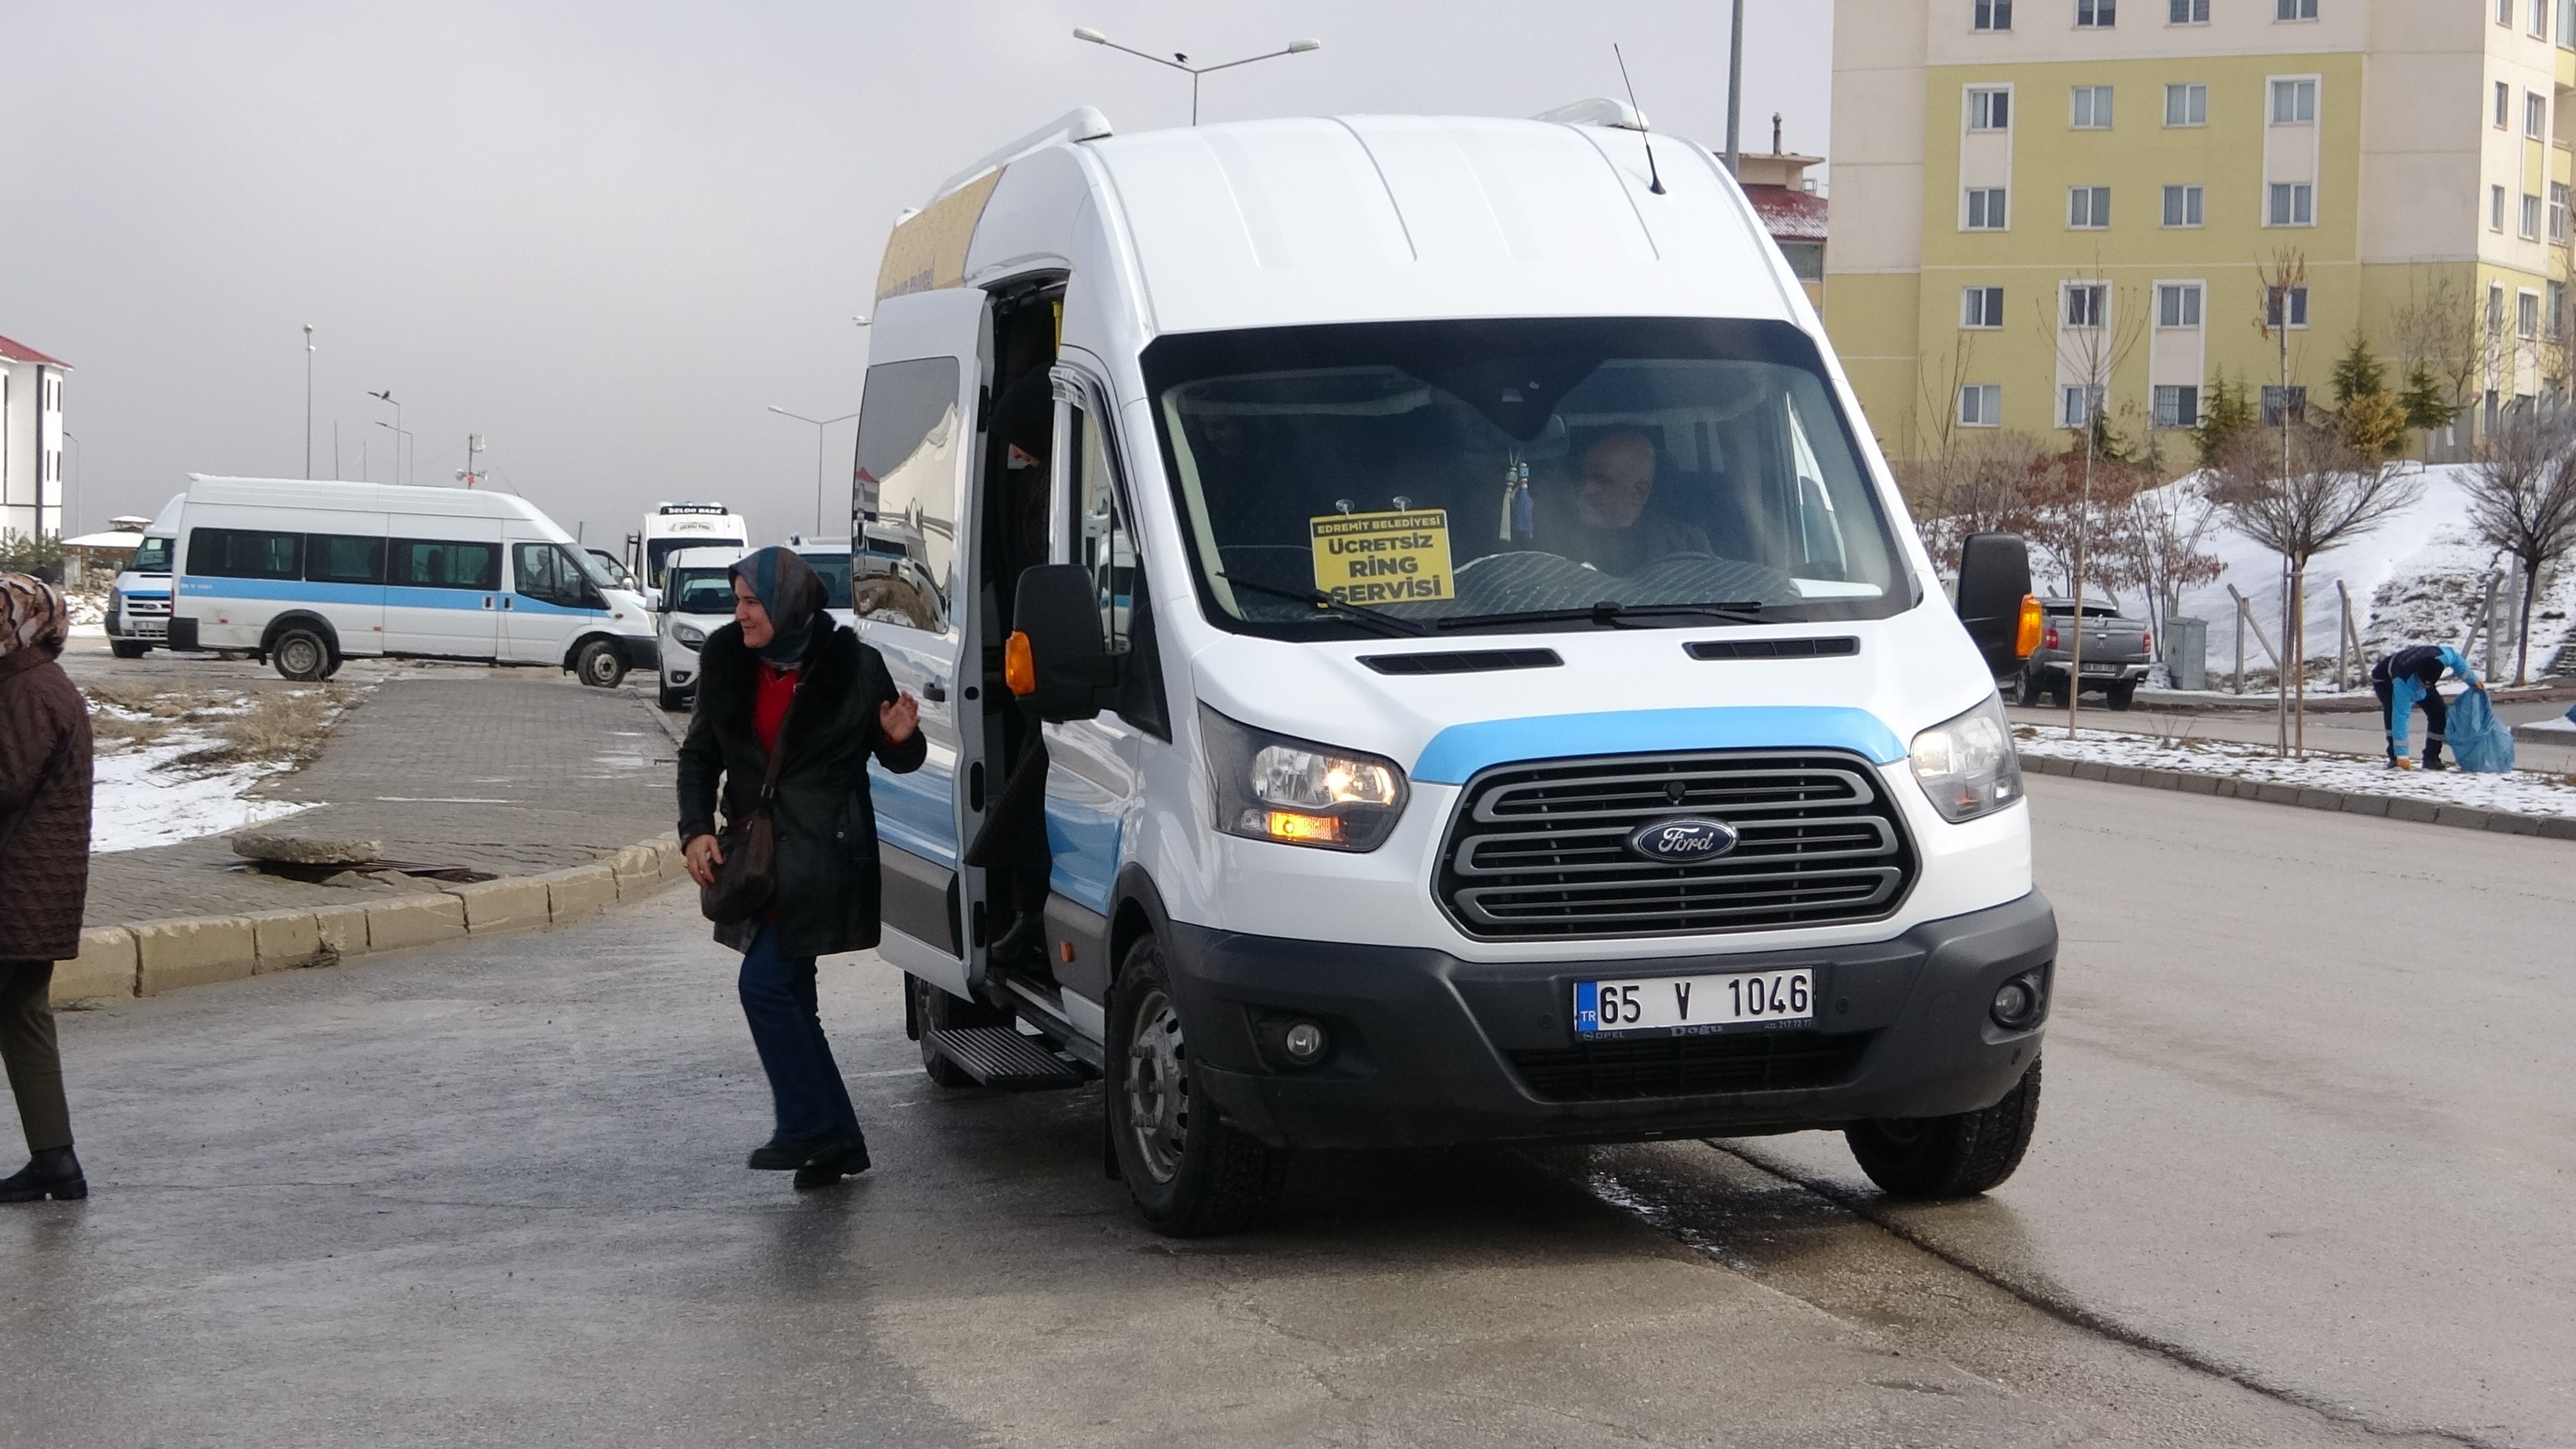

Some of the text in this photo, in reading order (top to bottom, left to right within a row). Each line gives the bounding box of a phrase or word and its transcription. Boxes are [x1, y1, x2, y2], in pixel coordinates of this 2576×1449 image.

[1318, 516, 1441, 534] EDREMİT BELEDİYESİ
[1328, 533, 1434, 555] ÜCRETSİZ
[1349, 555, 1419, 578] RİNG
[1330, 575, 1442, 602] SERVİSİ
[1658, 827, 1714, 853] Ford
[1600, 975, 1808, 1024] 65 V 1046
[1580, 1010, 1597, 1022] TR
[1595, 1031, 1625, 1040] OPEL
[1670, 1025, 1723, 1037] Doğu
